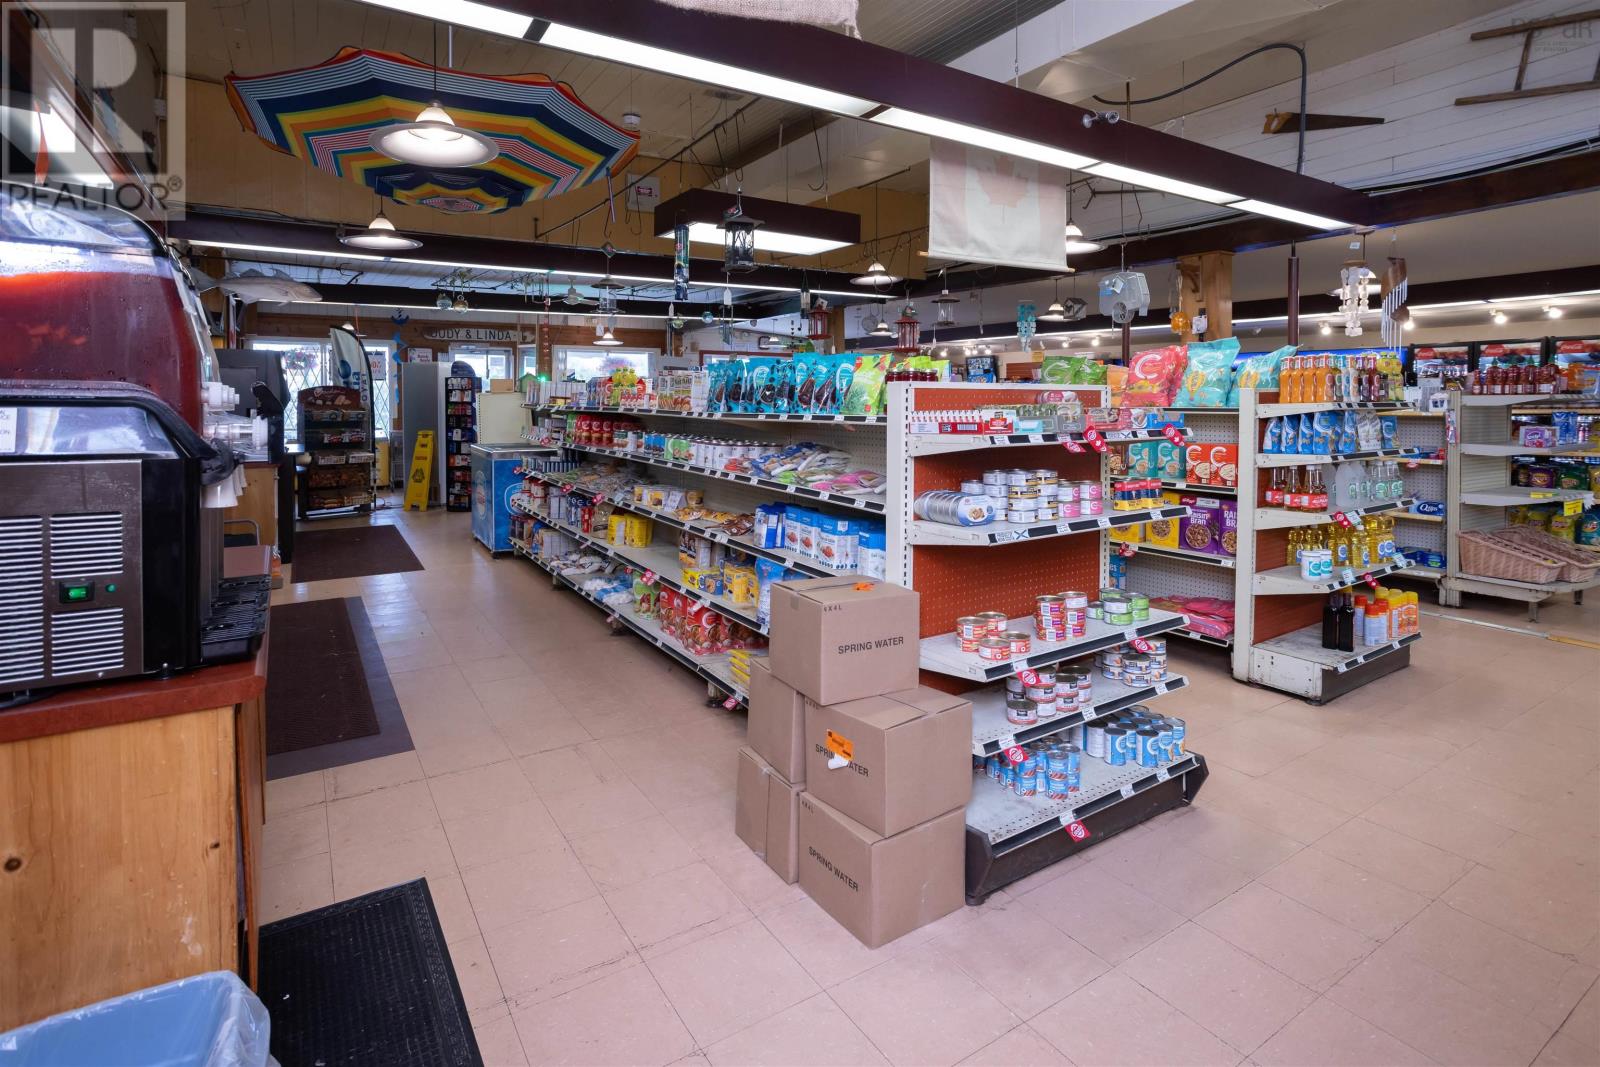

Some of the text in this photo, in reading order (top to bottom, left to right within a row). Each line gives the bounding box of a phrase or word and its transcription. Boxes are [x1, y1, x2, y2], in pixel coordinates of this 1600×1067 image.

[476, 329, 512, 341] LINDA
[838, 636, 904, 655] SPRING WATER
[815, 743, 835, 760] SPRIN
[847, 761, 869, 777] ATER
[808, 846, 859, 893] SPRING WATER
